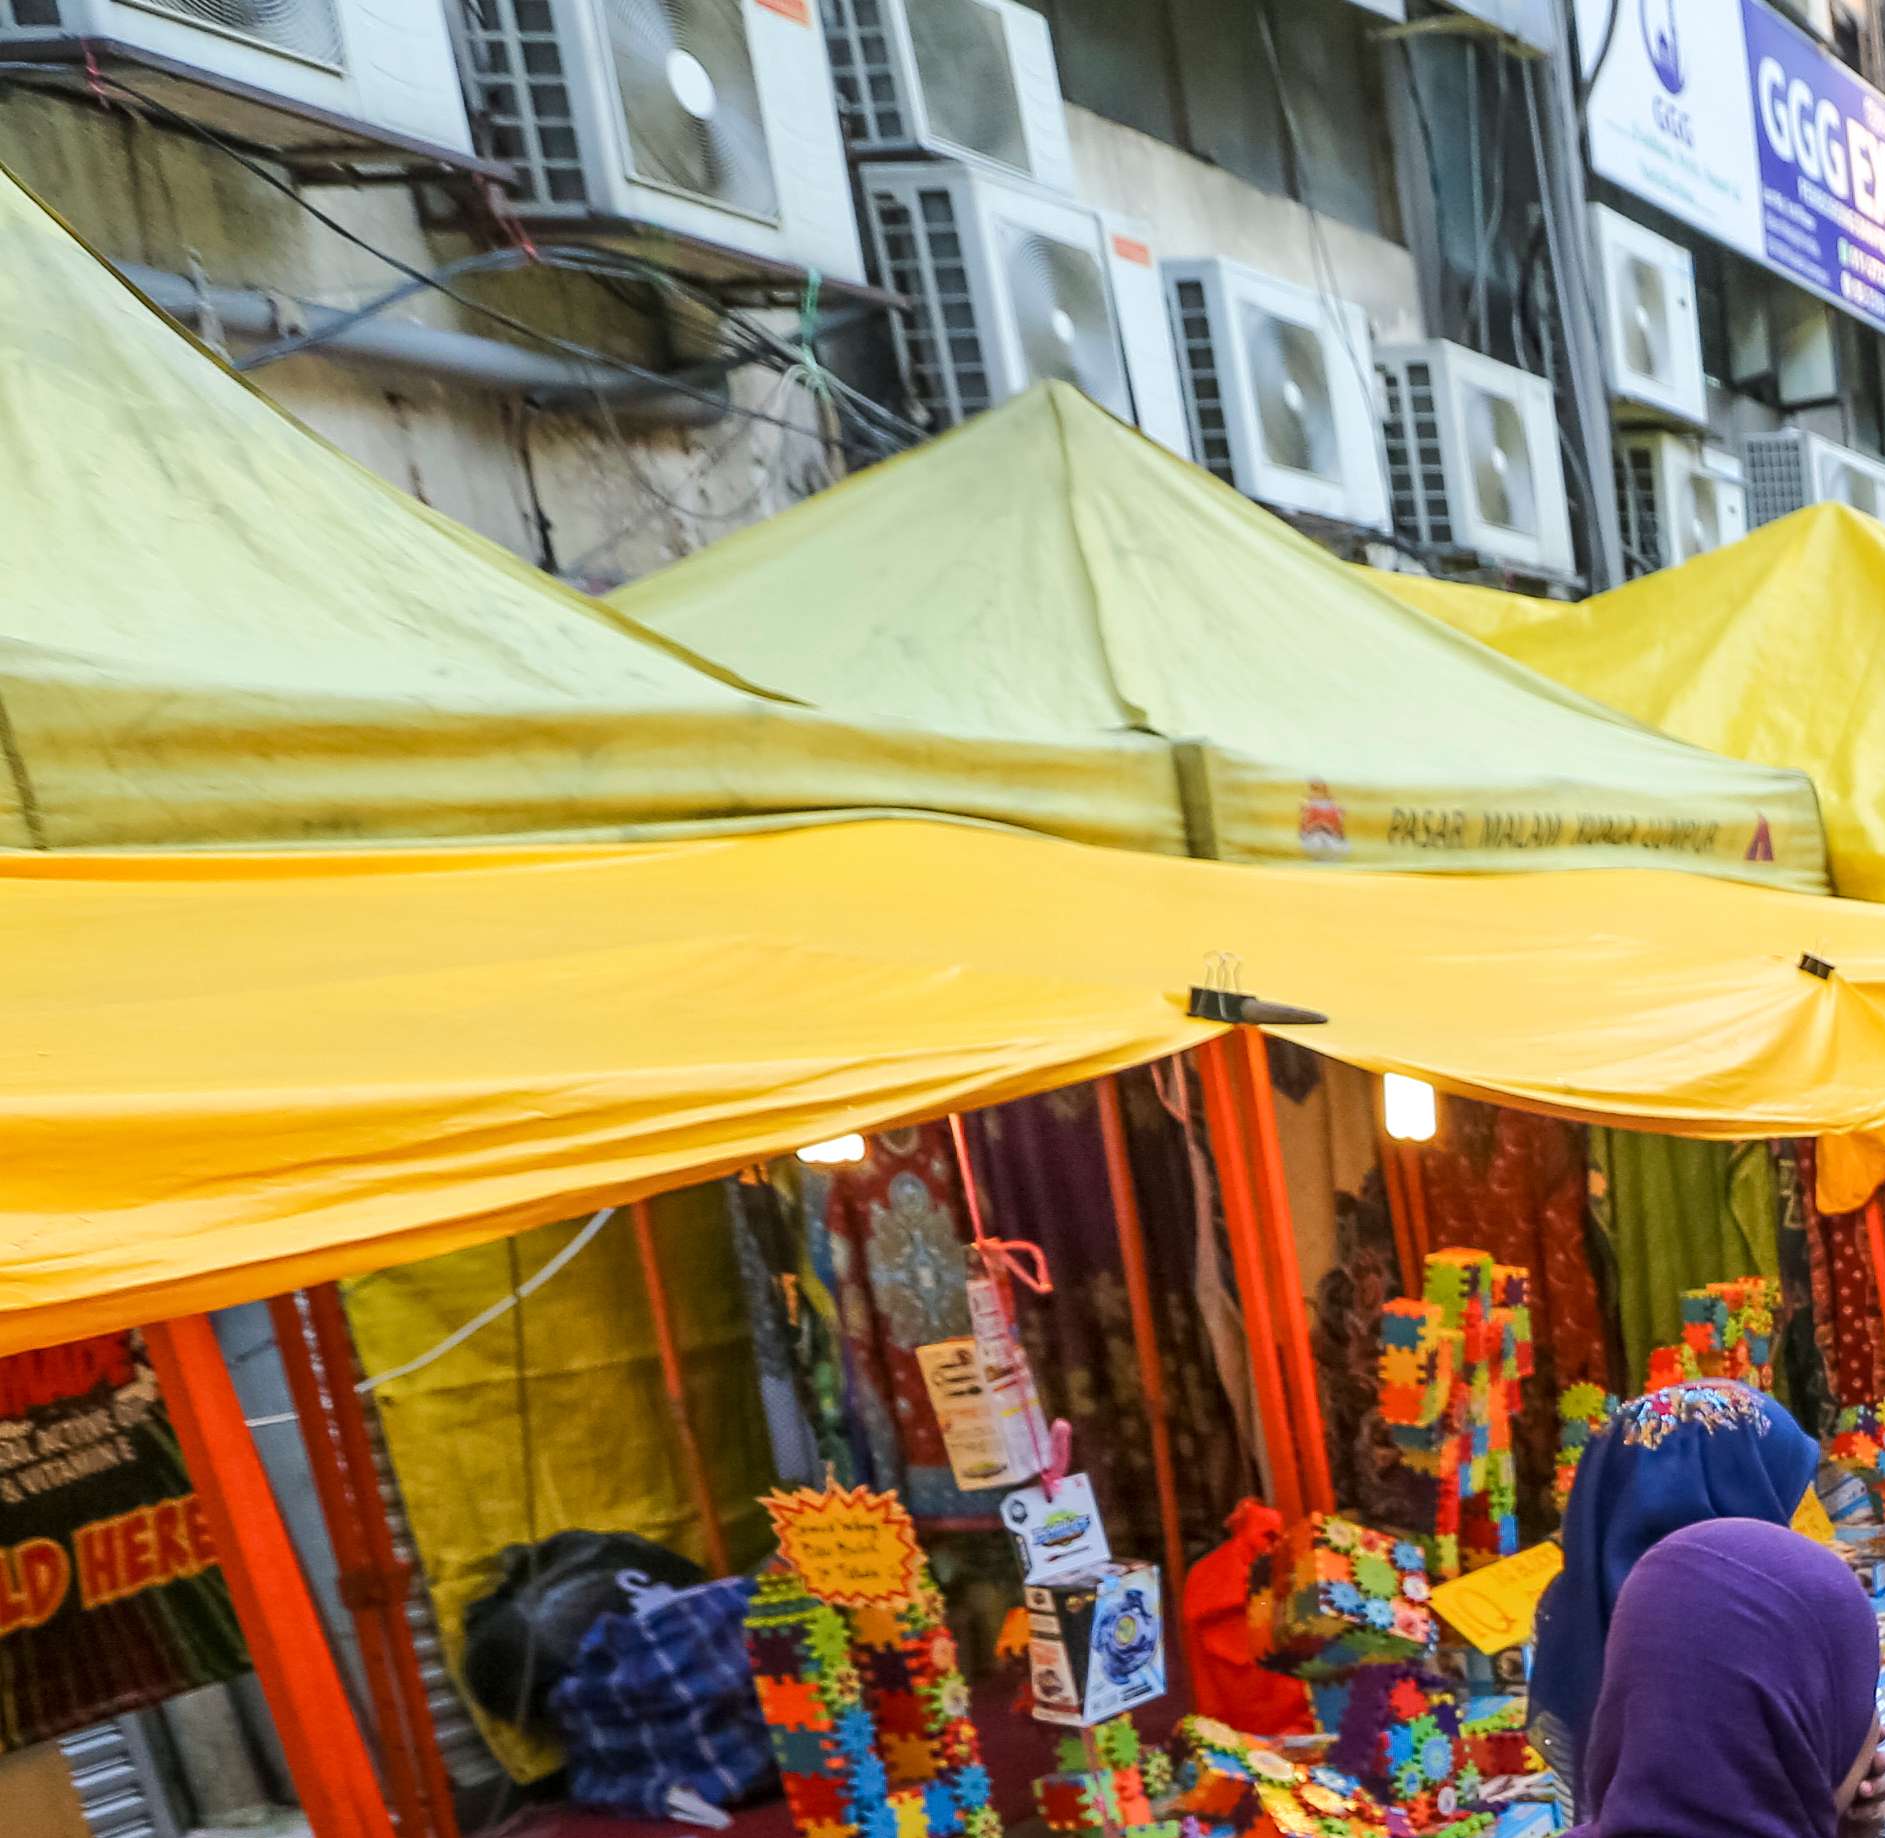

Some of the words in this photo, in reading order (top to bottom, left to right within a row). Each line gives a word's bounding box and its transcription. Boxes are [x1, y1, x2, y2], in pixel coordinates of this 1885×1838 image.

[1757, 56, 1849, 200] GGG
[1387, 805, 1467, 850] PASAR
[1477, 807, 1563, 850] MALAM
